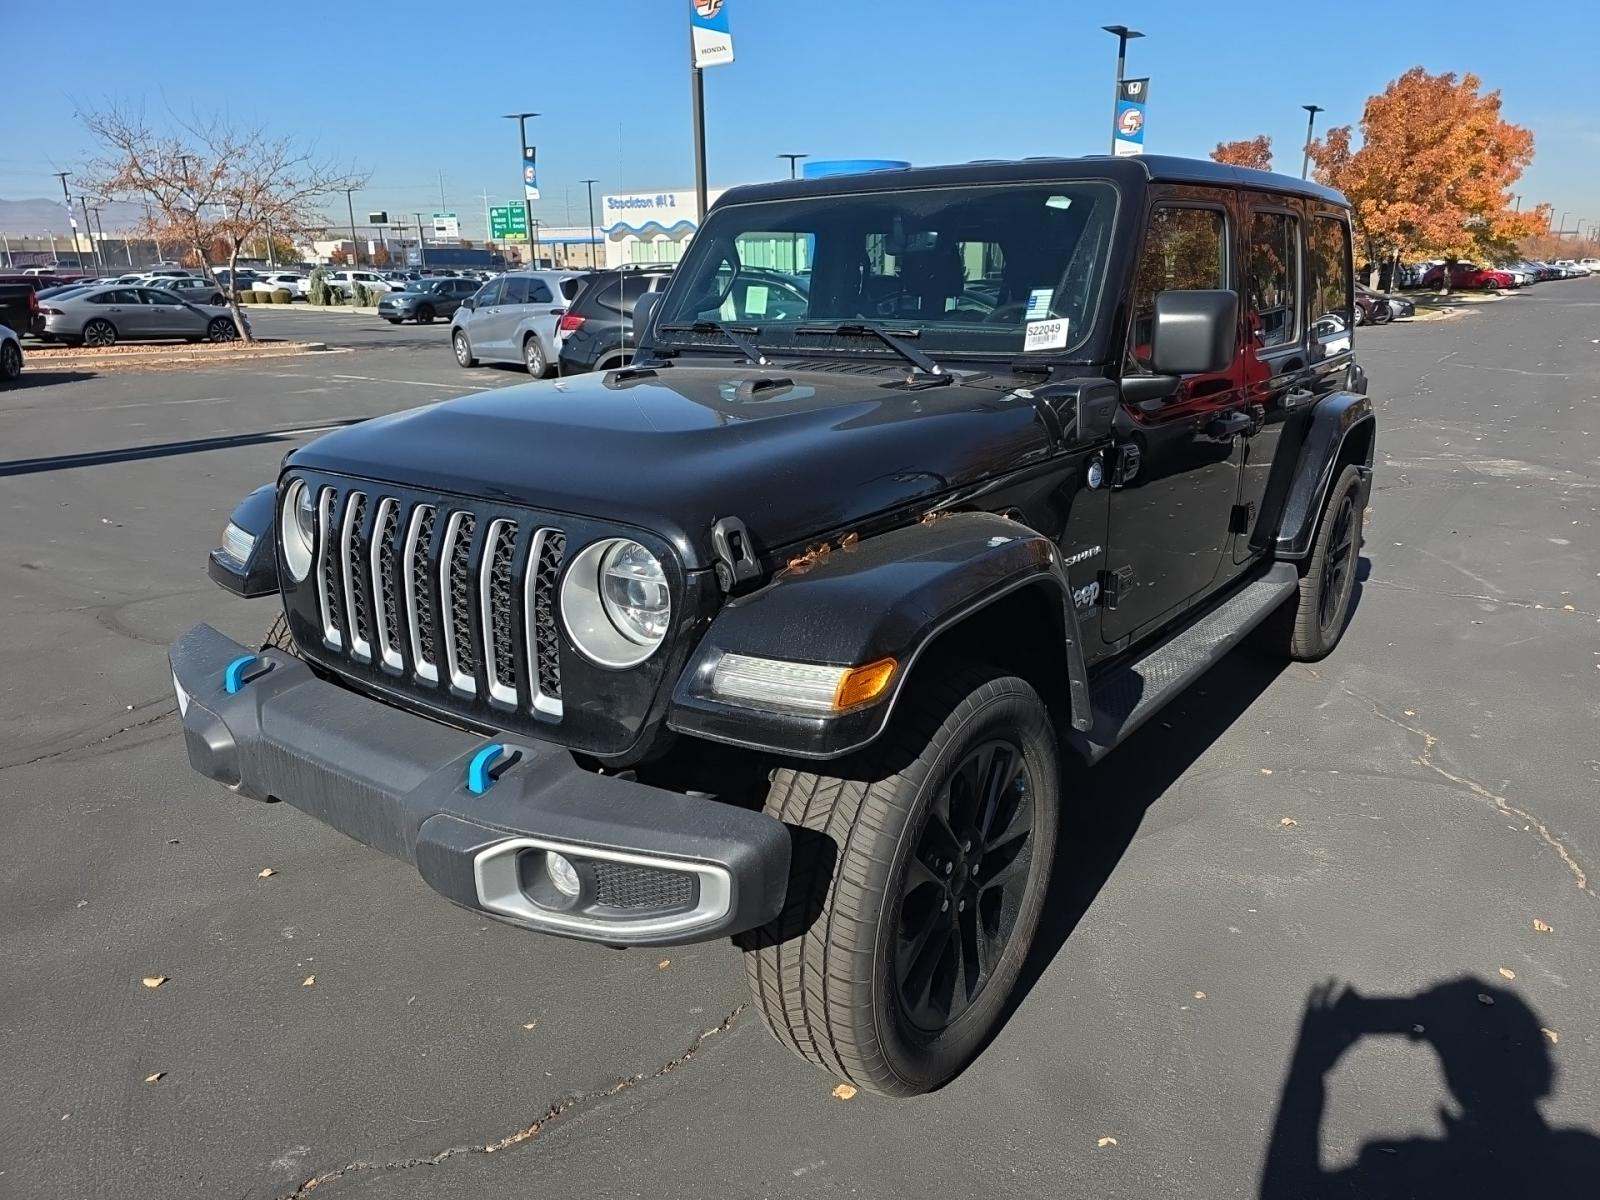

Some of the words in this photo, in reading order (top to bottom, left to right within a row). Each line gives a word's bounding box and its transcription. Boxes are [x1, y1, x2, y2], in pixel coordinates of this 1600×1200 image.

[701, 45, 727, 54] HONDA
[1027, 323, 1061, 336] S22049
[1072, 581, 1100, 608] eep
